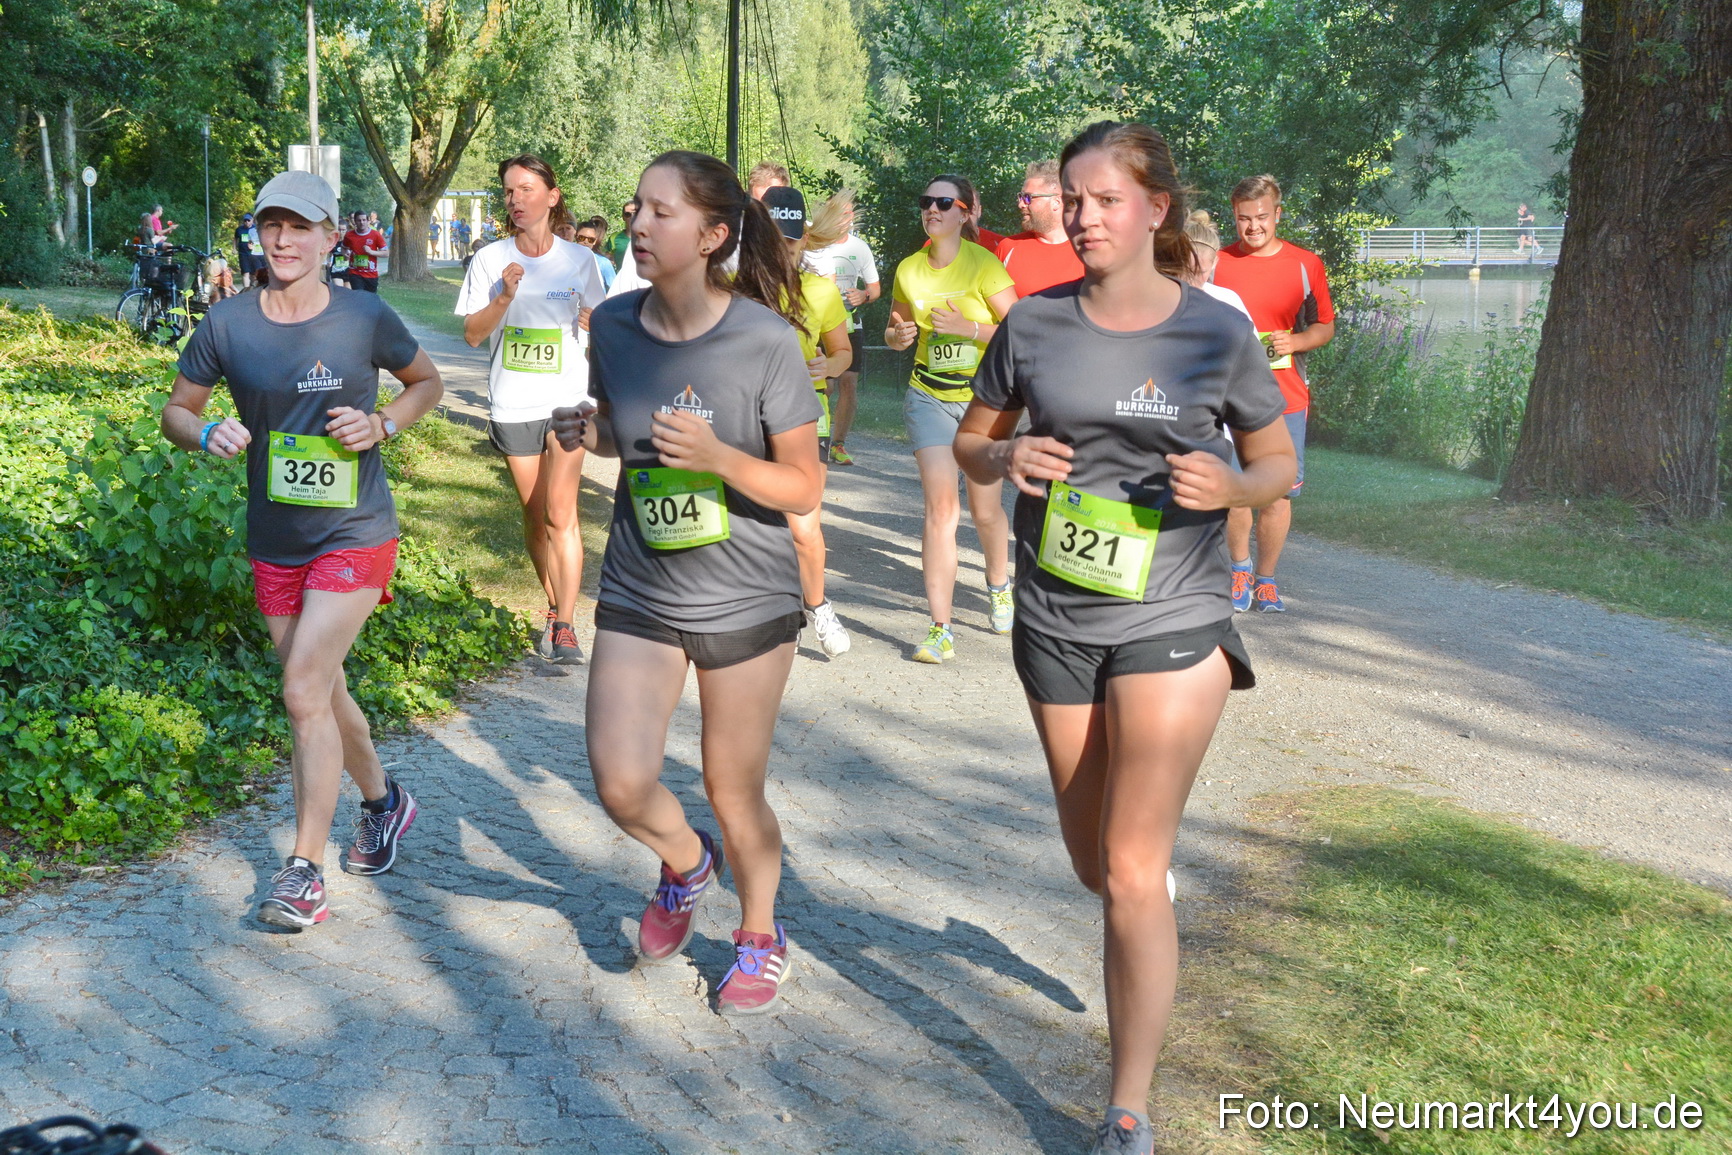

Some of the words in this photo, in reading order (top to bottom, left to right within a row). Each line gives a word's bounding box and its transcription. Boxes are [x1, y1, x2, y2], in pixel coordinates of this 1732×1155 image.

[769, 207, 803, 220] adidas
[511, 342, 555, 361] 1719
[934, 342, 963, 361] 907
[297, 378, 343, 389] BURKHARDT
[1115, 400, 1180, 416] BURKHARDT
[283, 459, 336, 487] 326
[291, 486, 309, 494] Heim
[311, 487, 327, 495] Taja
[643, 494, 701, 526] 304
[648, 527, 663, 536] Fiegl
[664, 525, 704, 535] Franziska
[1094, 518, 1118, 531] 2018
[1060, 521, 1120, 567] 321
[1053, 550, 1082, 568] Lederer
[1083, 563, 1123, 580] Johanna
[1060, 563, 1087, 577] Burkhardt
[1087, 573, 1108, 583] GmbH
